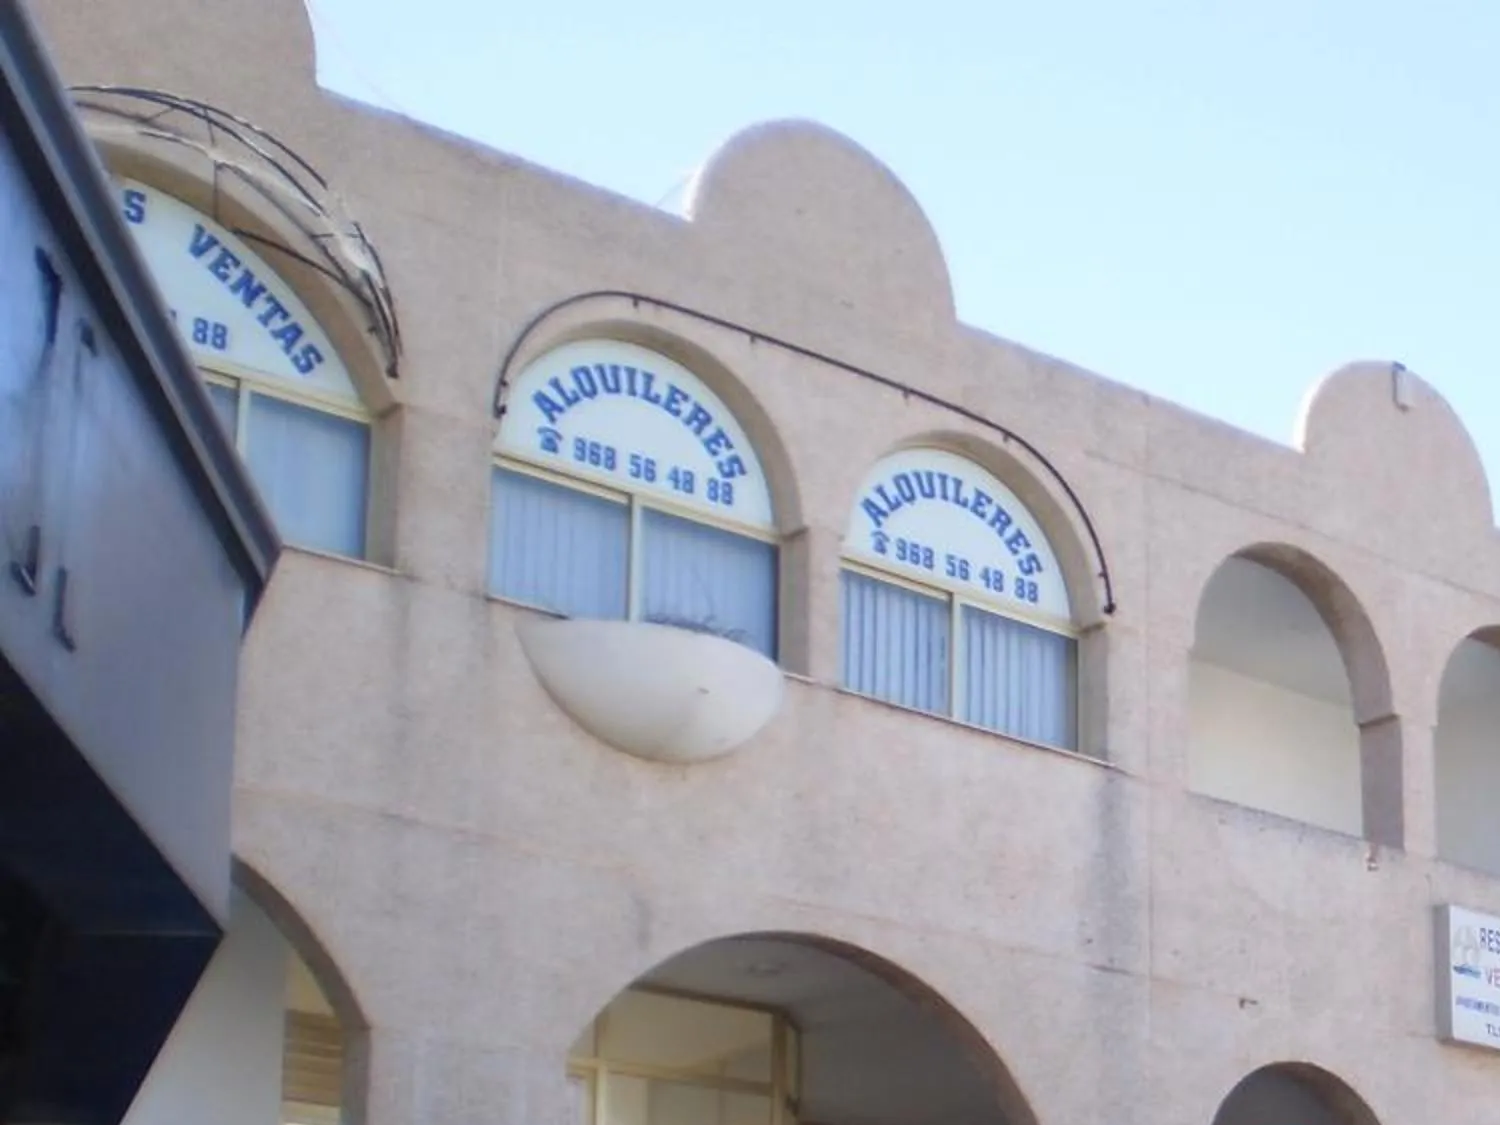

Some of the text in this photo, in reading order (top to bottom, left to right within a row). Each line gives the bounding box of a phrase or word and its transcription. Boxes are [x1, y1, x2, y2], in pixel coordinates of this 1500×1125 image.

[187, 224, 324, 376] VENTAS
[192, 316, 229, 351] 88
[531, 363, 748, 479] ALQUILERES
[573, 437, 734, 506] 968 56 48 88
[860, 470, 1044, 577] ALQUILERES
[896, 538, 1039, 604] 968 56 48 88
